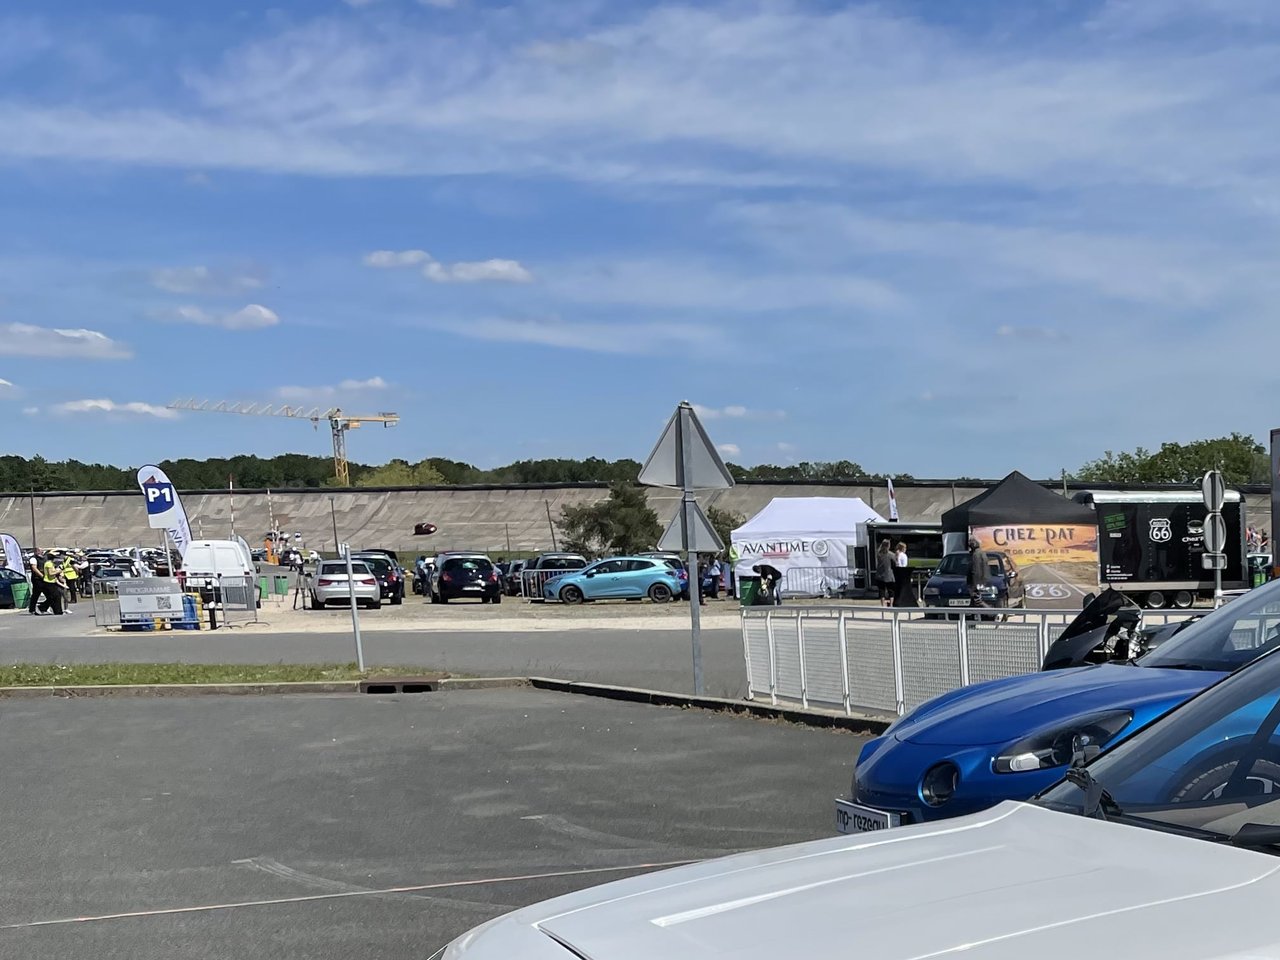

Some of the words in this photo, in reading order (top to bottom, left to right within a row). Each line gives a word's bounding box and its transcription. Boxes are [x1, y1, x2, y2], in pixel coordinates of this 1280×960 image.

[147, 487, 172, 502] P1
[993, 527, 1036, 547] CHEZ
[1152, 527, 1170, 540] 66
[742, 541, 809, 554] AVANTIME
[1030, 585, 1063, 597] 66
